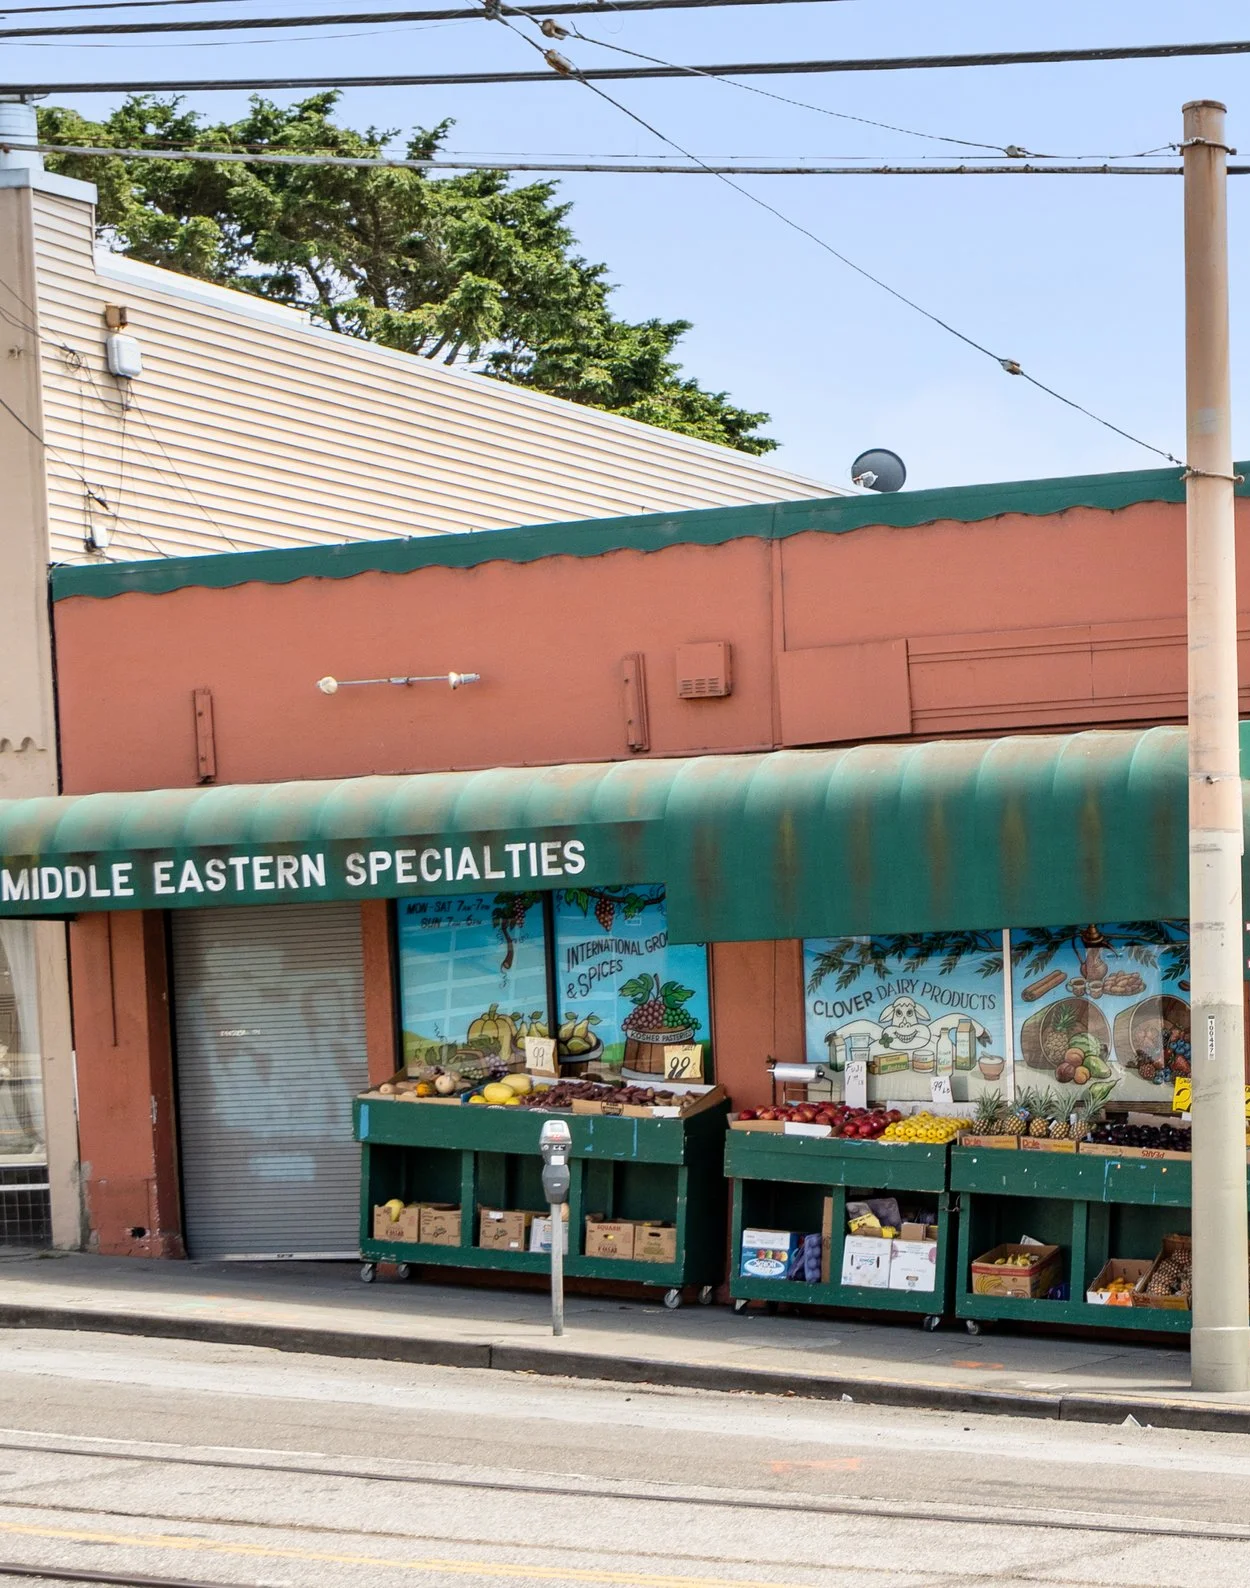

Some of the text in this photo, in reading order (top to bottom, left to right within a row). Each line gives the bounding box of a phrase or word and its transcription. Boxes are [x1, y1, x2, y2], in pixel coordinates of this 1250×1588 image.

[2, 840, 586, 900] MIDDLE EASTERN SPECIALTIES
[567, 931, 669, 973] INTERNATIONAL GRO
[567, 960, 623, 999] & SPICES
[813, 978, 997, 1018] CLOVER DAIRY PRODUCTS
[631, 1031, 660, 1042] KOSHER
[1022, 1139, 1040, 1149] Dole
[1141, 1150, 1165, 1159] PEARS
